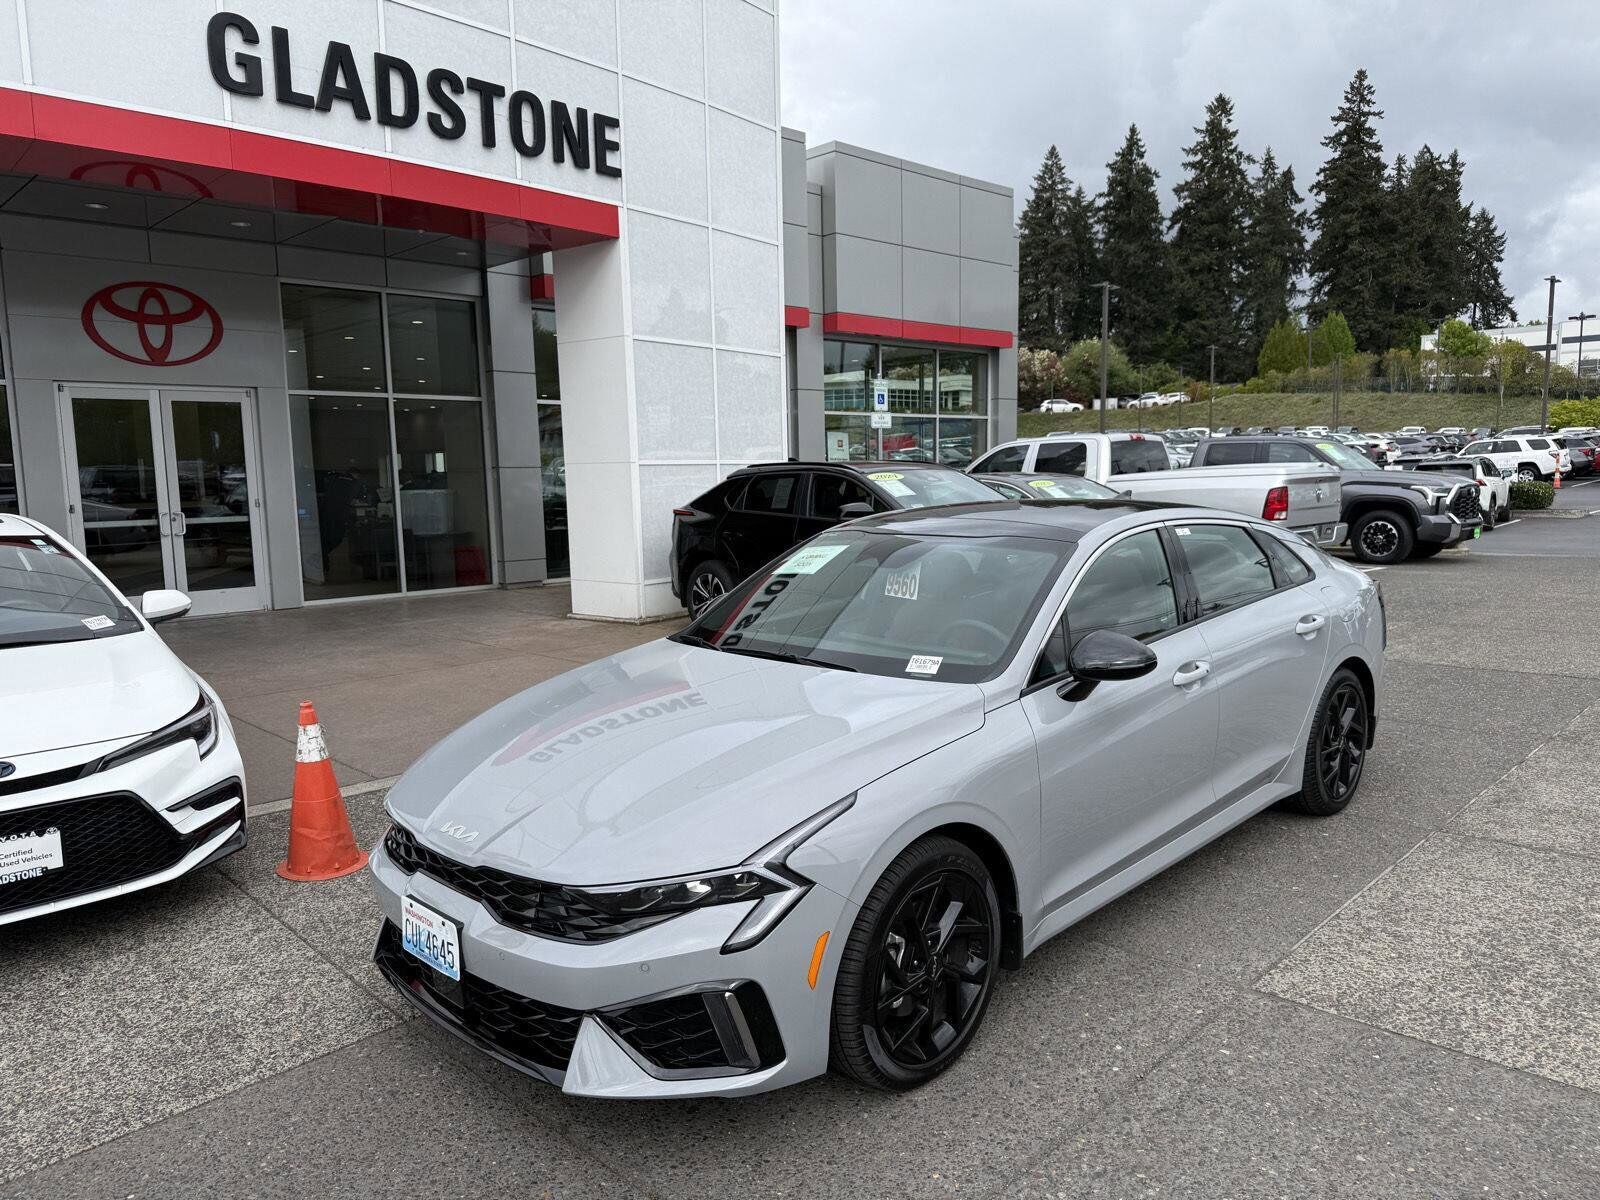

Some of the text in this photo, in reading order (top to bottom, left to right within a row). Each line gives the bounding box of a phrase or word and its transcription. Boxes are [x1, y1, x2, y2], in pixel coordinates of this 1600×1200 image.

[206, 11, 622, 178] GLADSTONE
[886, 572, 918, 599] 9560
[0, 831, 37, 843] YOTA
[440, 820, 480, 843] KIA
[0, 852, 53, 868] Used Vehicles
[0, 867, 43, 885] DSTONE
[404, 906, 434, 928] WASHINGTON
[405, 918, 455, 970] CUL4645
